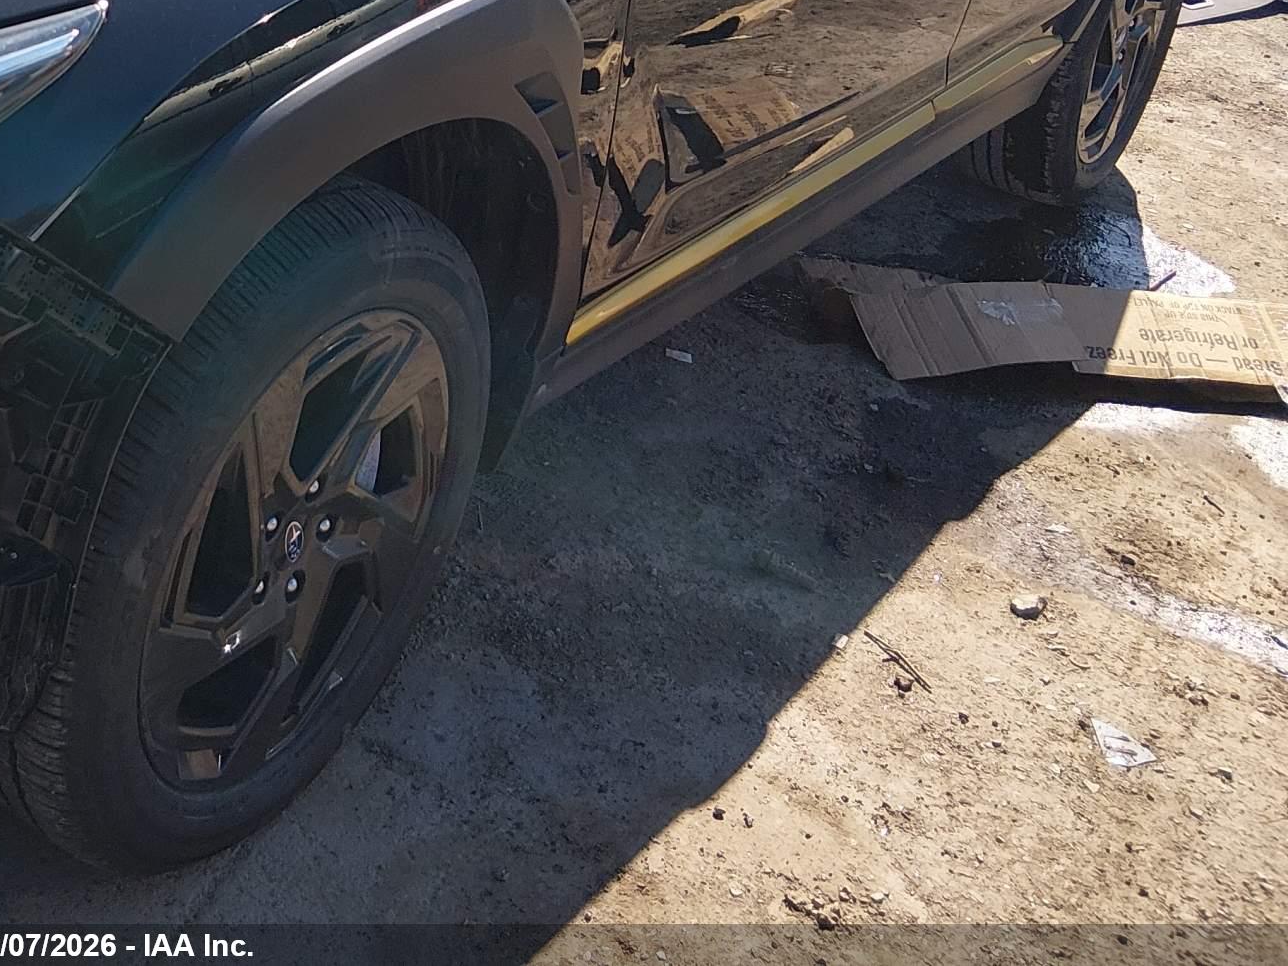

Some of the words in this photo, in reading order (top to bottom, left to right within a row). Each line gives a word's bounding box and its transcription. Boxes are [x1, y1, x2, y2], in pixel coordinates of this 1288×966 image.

[1138, 328, 1239, 351] Refrigerate
[1241, 336, 1259, 350] or
[1139, 350, 1173, 367] Not
[1176, 351, 1203, 368] Do
